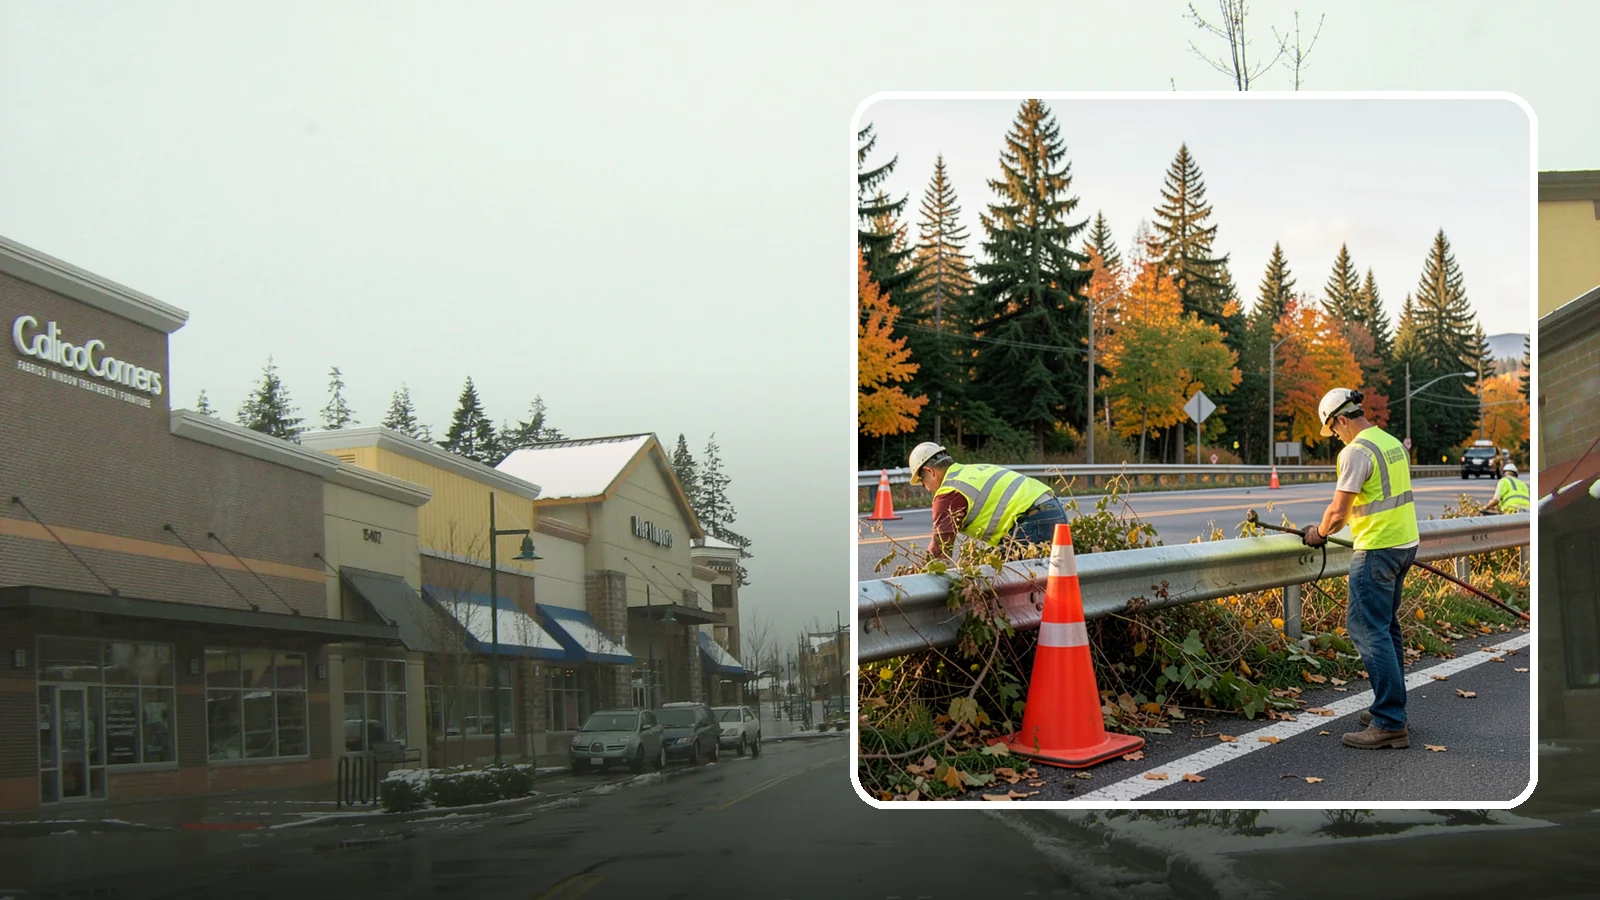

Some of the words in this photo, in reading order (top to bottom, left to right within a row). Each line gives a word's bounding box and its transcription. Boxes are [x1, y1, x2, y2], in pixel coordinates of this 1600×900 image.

[17, 360, 47, 378] FABRICS
[50, 370, 78, 387] WINDOW
[78, 378, 117, 398] TREATMENTS
[120, 391, 151, 409] FURNITURE
